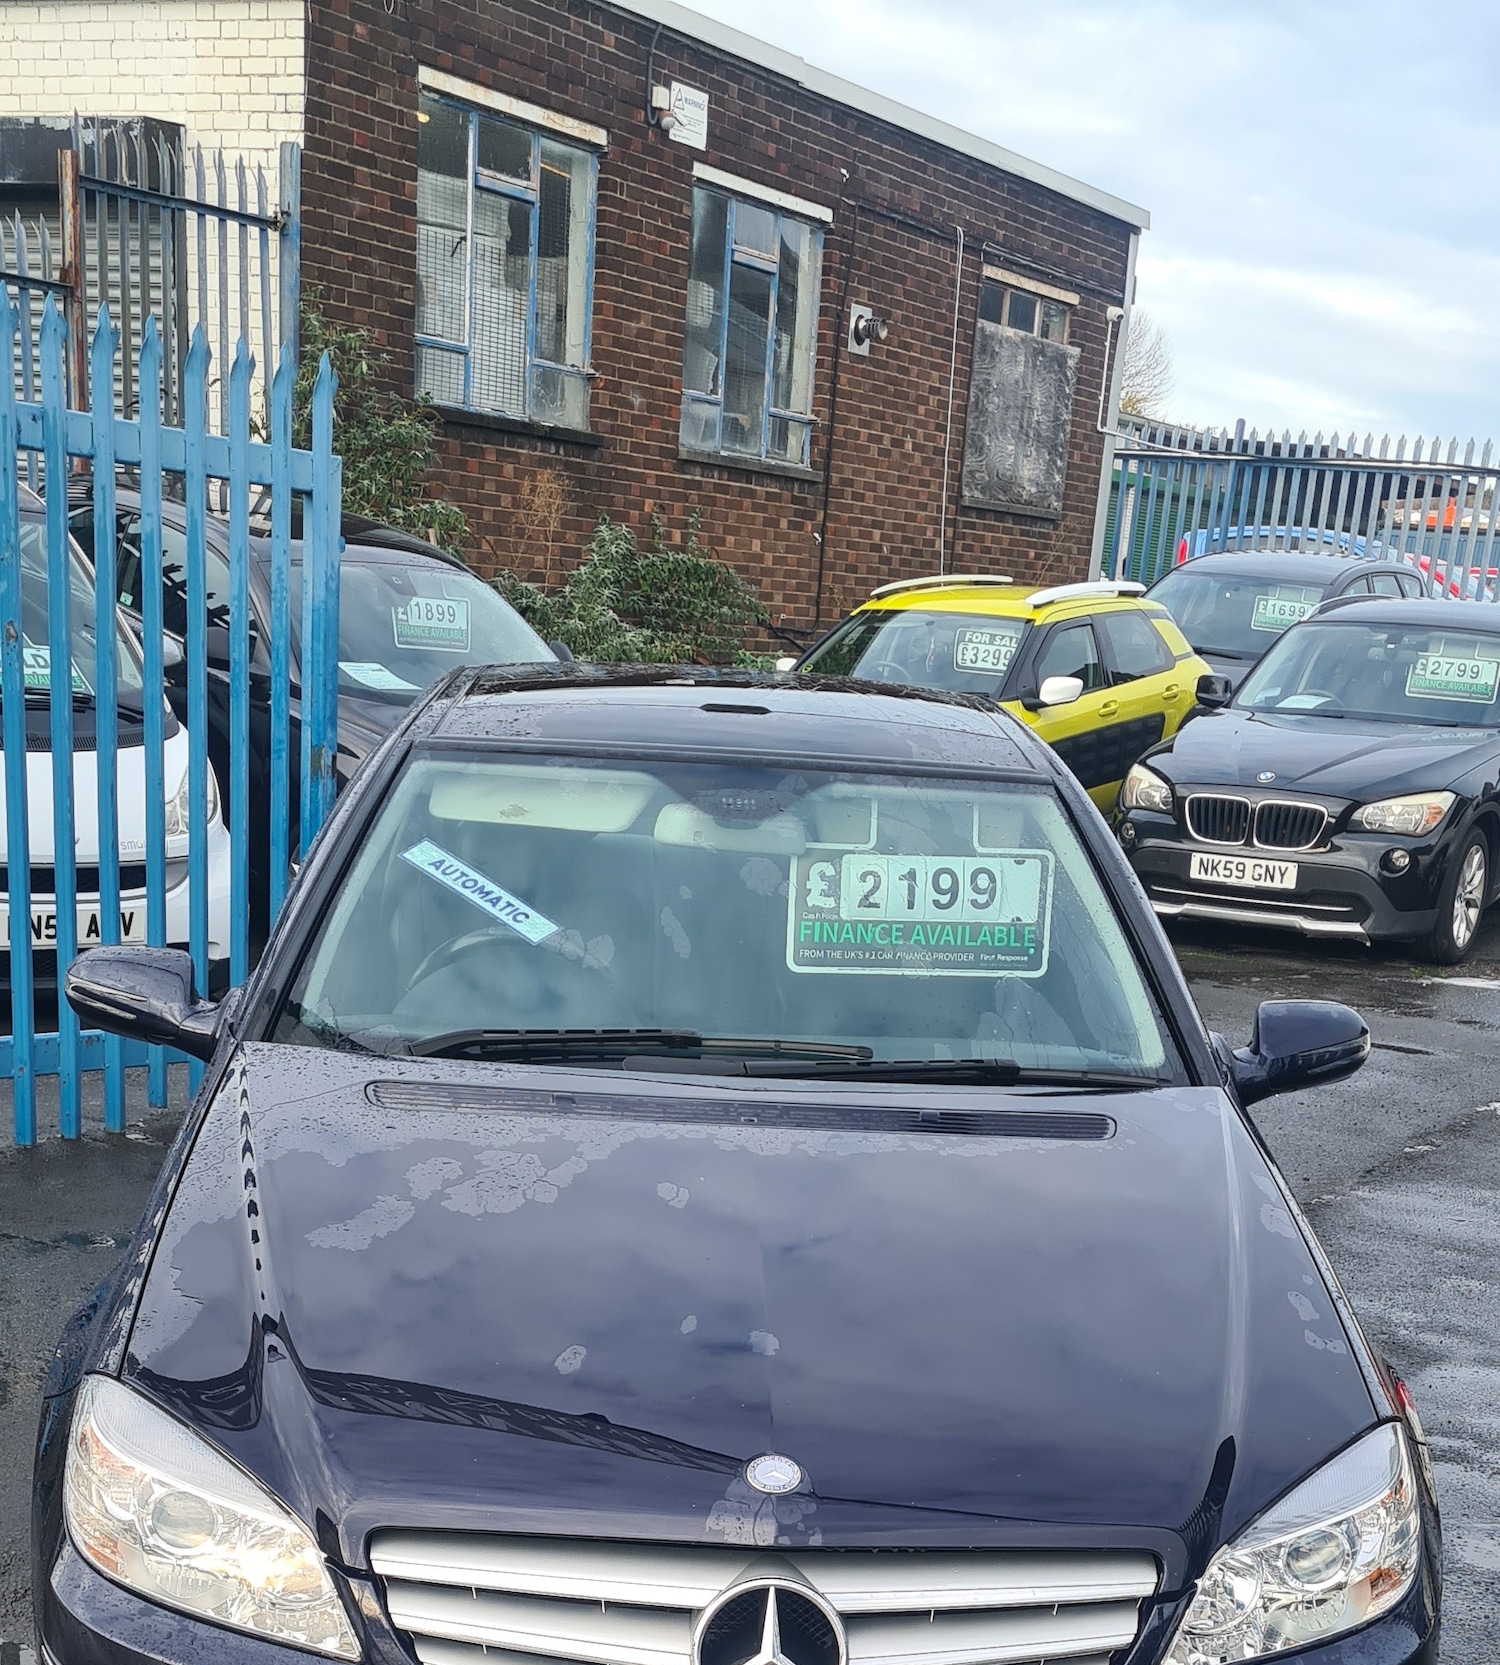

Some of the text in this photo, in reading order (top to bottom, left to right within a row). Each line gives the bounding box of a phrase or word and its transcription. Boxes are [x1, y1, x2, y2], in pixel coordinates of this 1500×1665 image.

[965, 631, 1019, 648] FOR SAL
[1411, 677, 1447, 689] FINANCE
[1447, 681, 1493, 694] AVAILABLE
[1198, 857, 1289, 884] NK59 GNY
[427, 859, 530, 924] AUTOMATIC
[86, 911, 134, 938] AV
[799, 920, 1037, 947] FINANCE AVAILABLE
[799, 949, 824, 959] FROM
[826, 949, 843, 959] THE
[844, 950, 863, 960] UK'S
[877, 951, 894, 960] CAR
[933, 952, 975, 962] PROVIDER
